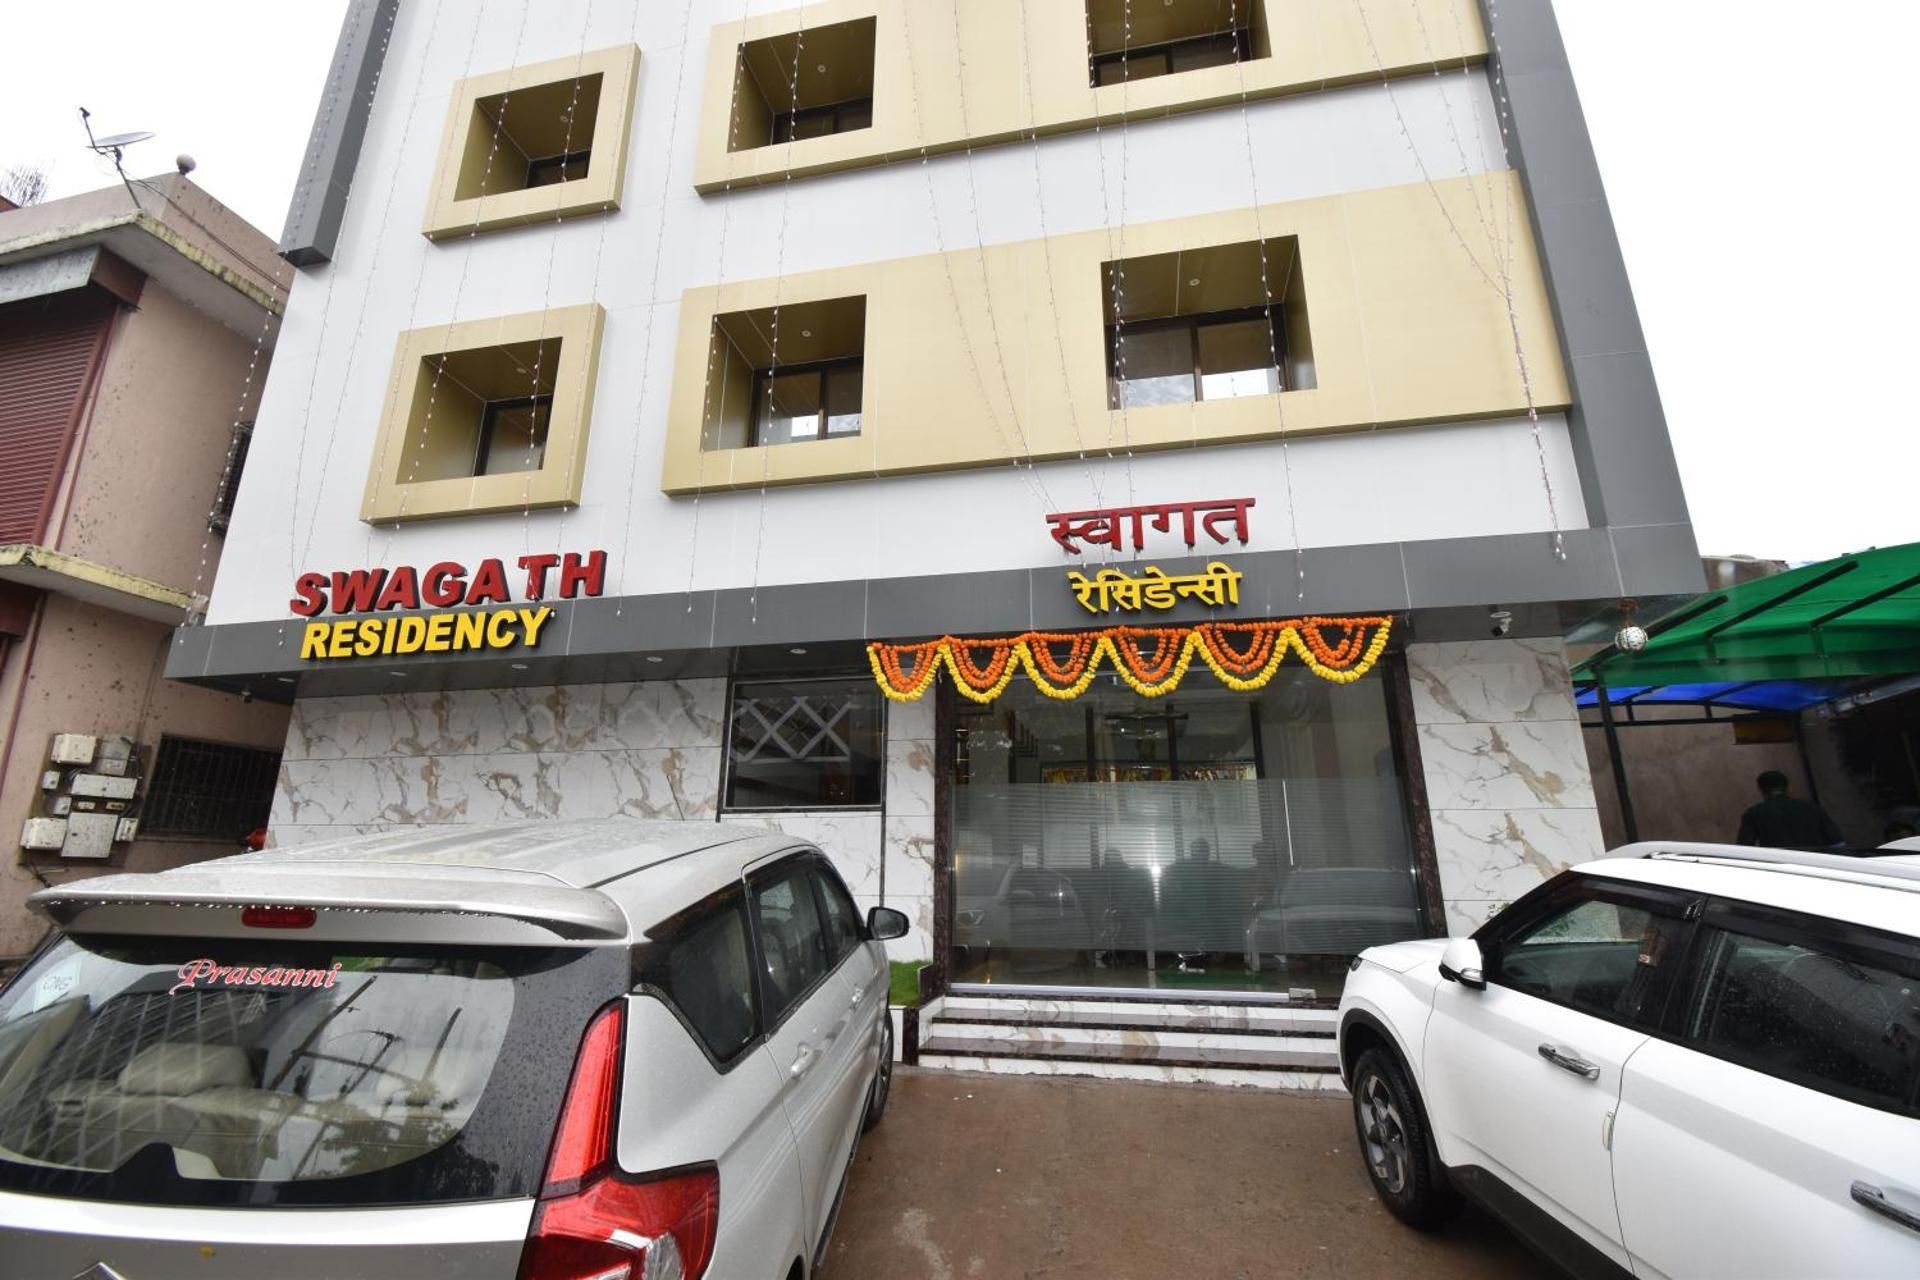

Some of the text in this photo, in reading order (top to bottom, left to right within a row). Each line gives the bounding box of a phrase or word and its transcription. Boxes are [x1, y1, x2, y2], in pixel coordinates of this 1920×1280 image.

[1046, 498, 1256, 554] स्वागत
[290, 550, 608, 616] SWAGATH
[1067, 561, 1243, 612] रेसिडेन्सी
[300, 608, 551, 659] RESIDENCY
[168, 958, 342, 995] Prasanni
